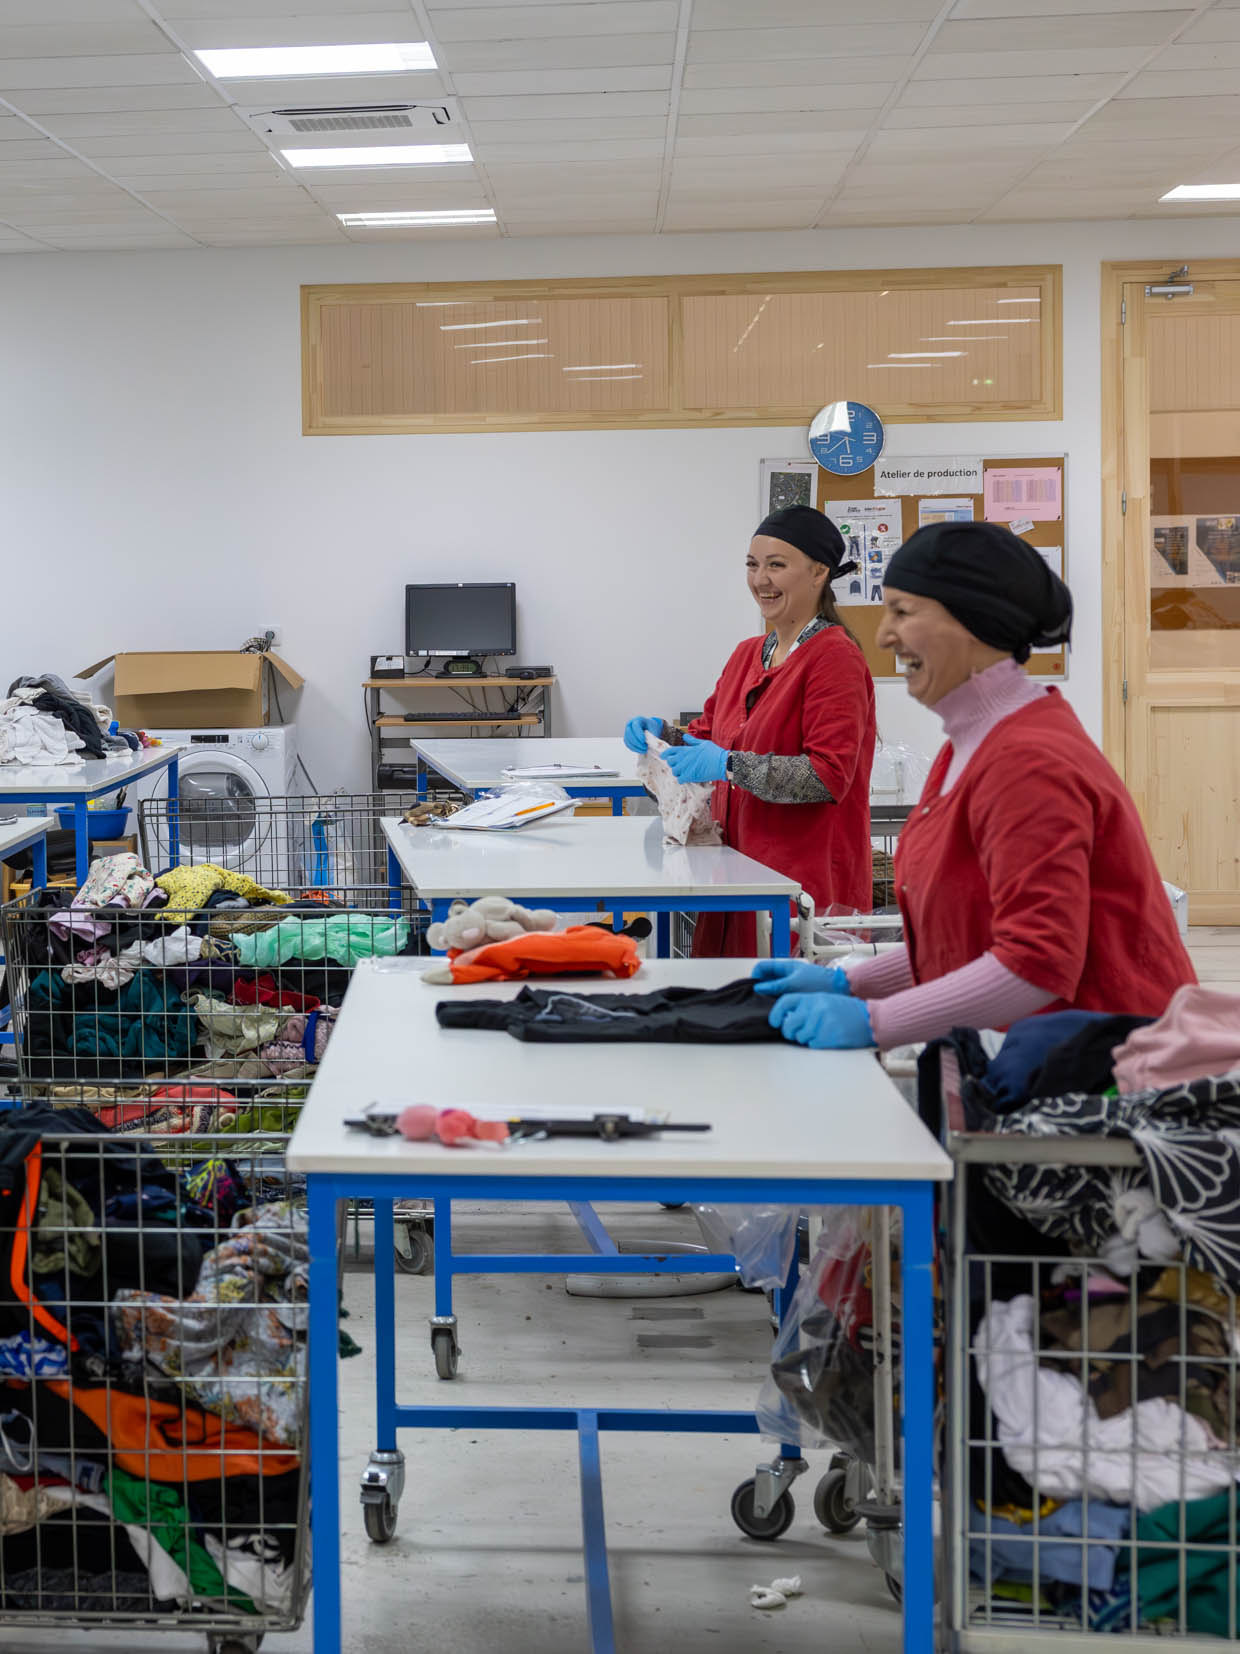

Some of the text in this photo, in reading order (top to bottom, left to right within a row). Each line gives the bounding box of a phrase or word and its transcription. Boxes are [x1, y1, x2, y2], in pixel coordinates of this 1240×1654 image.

[863, 432, 877, 444] 3
[840, 455, 853, 467] 6
[880, 468, 978, 479] Atelier de production
